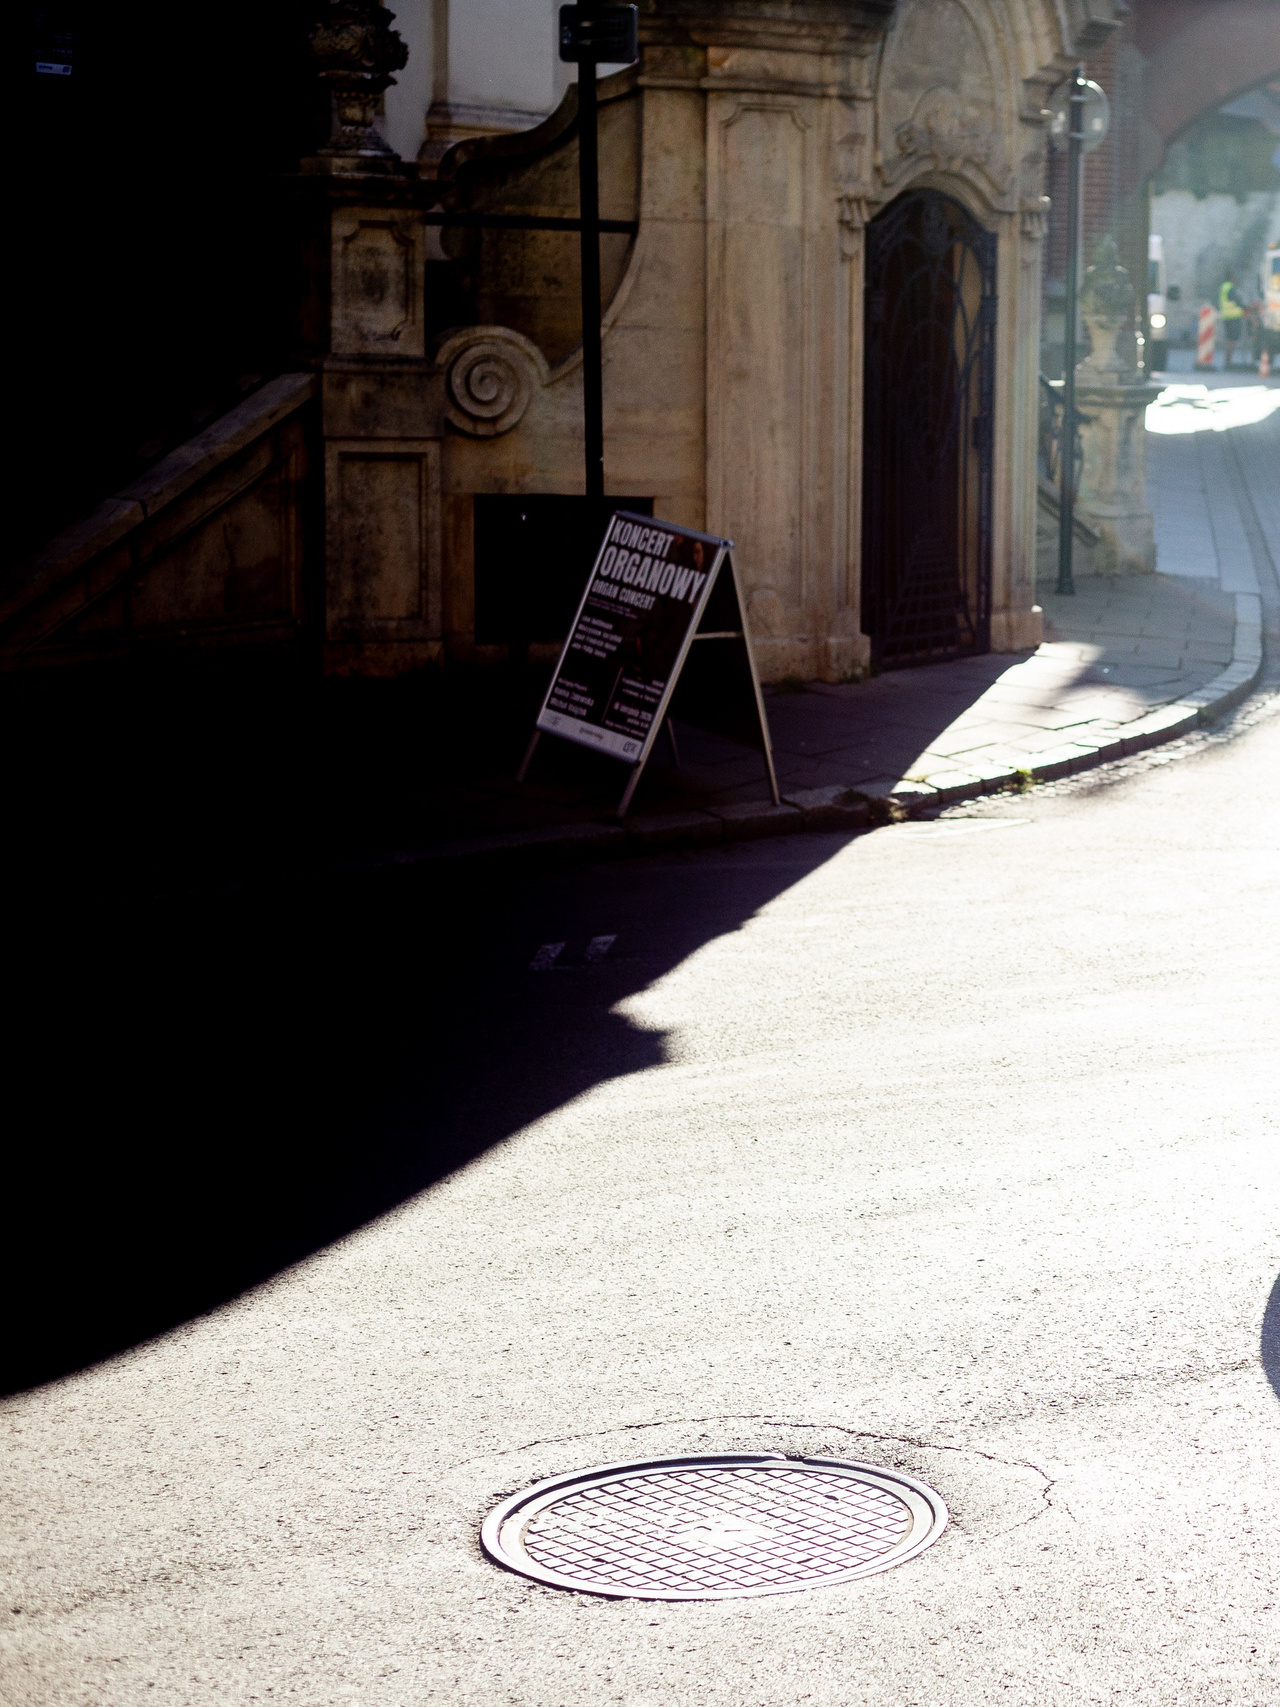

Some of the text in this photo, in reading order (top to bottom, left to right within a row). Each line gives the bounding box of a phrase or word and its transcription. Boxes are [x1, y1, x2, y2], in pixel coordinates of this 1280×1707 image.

[610, 519, 675, 559] KONCERT
[591, 578, 620, 600] ORGAN
[618, 587, 657, 611] CONCERT
[600, 545, 707, 605] ORGANOWY
